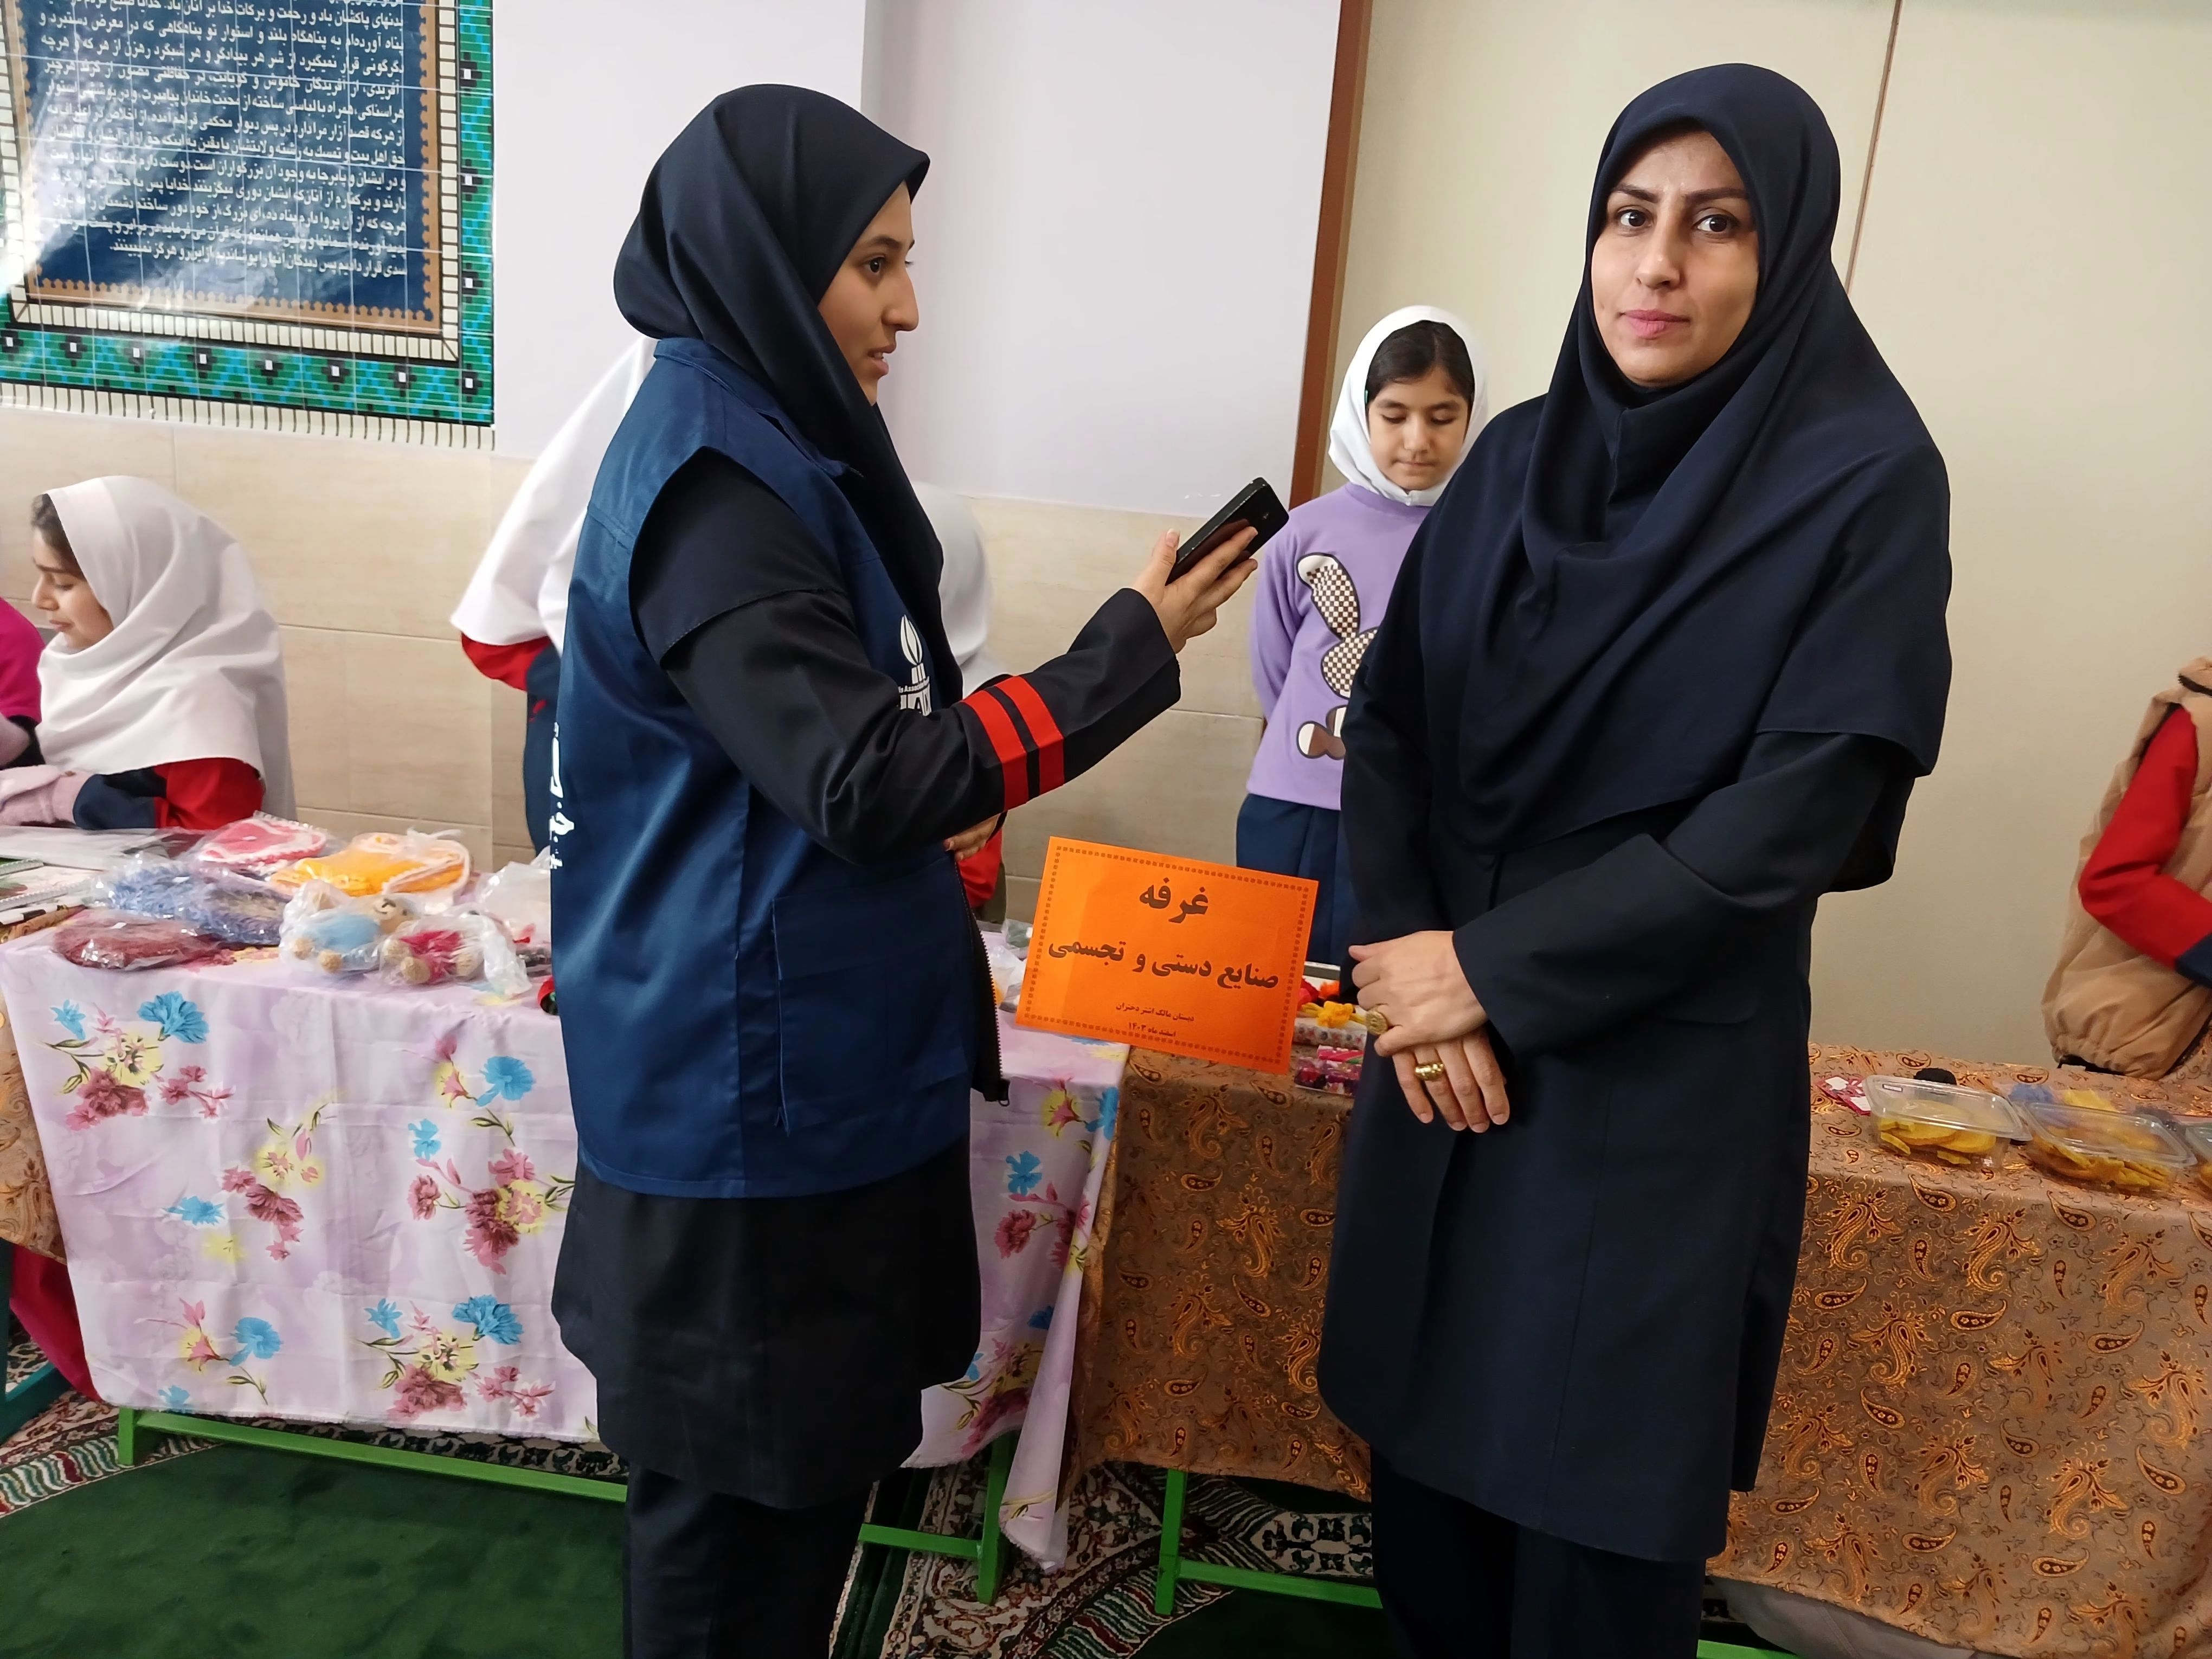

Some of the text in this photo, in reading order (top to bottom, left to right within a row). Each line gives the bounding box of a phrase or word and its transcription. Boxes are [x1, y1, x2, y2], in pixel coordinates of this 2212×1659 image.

[205, 4, 216, 17] بر
[217, 1, 234, 14] خدا
[267, 8, 274, 22] و
[276, 7, 307, 24] رحمت
[38, 11, 46, 26] و
[91, 14, 123, 33] معرض
[143, 18, 155, 30] که
[308, 11, 315, 25] و
[318, 8, 332, 25] باد
[126, 20, 139, 34] در
[158, 19, 202, 40] پناهگاهی
[206, 23, 217, 41] تو
[220, 24, 253, 43] استوار
[256, 30, 264, 44] و
[267, 27, 287, 46] بلند
[292, 29, 326, 49] پناهگاه
[330, 35, 341, 50] به
[112, 37, 121, 56] از
[124, 41, 151, 59] رهزن
[153, 41, 185, 61] شبگرد
[385, 36, 403, 55] پناه
[188, 46, 201, 63] هر
[204, 49, 211, 63] و
[214, 46, 248, 66] بیدادگر
[251, 51, 265, 67] هر
[268, 49, 284, 68] شر
[287, 50, 297, 69] از
[339, 56, 359, 75] قرار
[252, 75, 259, 89] و
[131, 89, 137, 103] و
[181, 89, 211, 107] خاندان
[242, 93, 250, 112] از
[252, 95, 284, 108] ساخته
[138, 108, 146, 126] از
[199, 114, 233, 132] محکمی
[260, 123, 278, 137] پس
[279, 124, 292, 137] در
[146, 178, 163, 195] پس
[356, 169, 384, 190] ایشان
[385, 176, 397, 190] در
[398, 176, 406, 191] و
[325, 189, 333, 208] از
[373, 198, 380, 211] و
[169, 203, 188, 217] دور
[355, 214, 364, 233] از
[1139, 876, 1208, 923] غرفه
[1049, 941, 1279, 989] صنایع دستی و تجسمی
[1155, 1009, 1171, 1018] مالک
